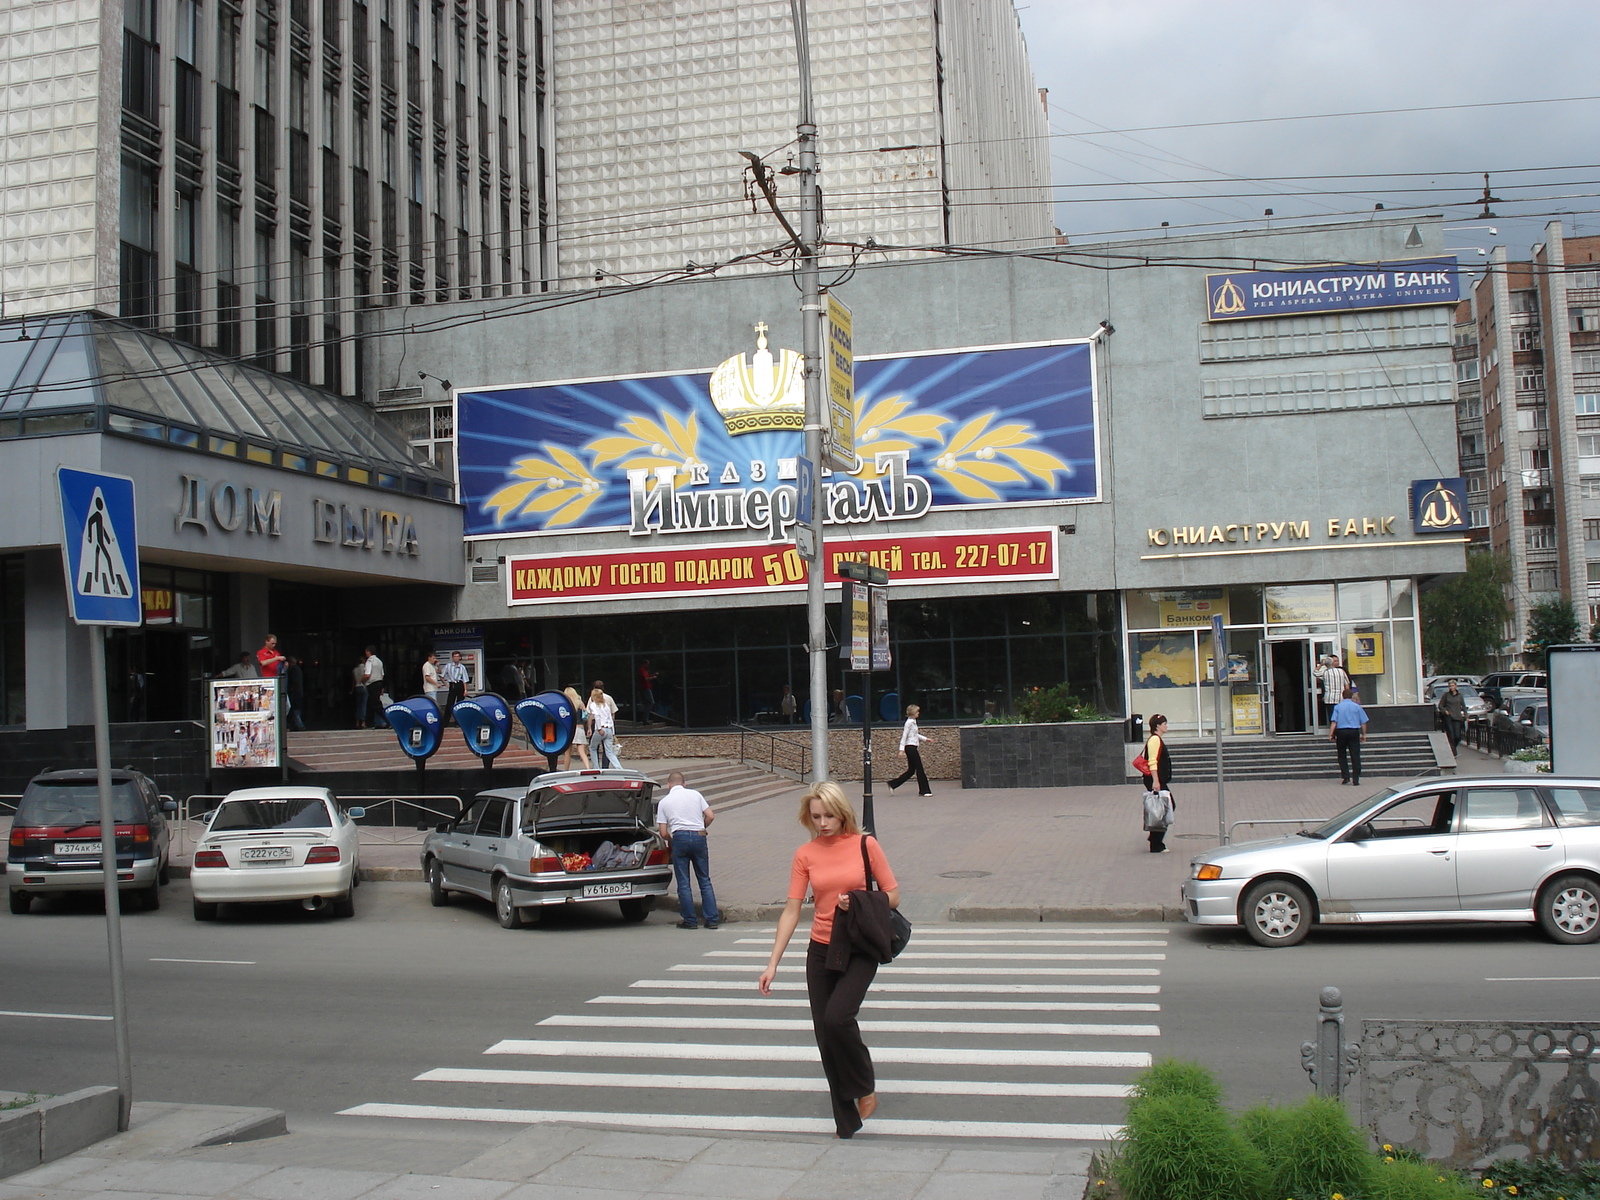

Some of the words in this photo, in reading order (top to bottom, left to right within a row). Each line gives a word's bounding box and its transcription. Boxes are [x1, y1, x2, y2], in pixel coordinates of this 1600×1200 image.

[1252, 273, 1386, 299] ЮНИАСТРУМ
[1394, 270, 1450, 288] БАНК
[1254, 300, 1275, 308] PER
[1280, 297, 1322, 306] ASPERA
[1328, 295, 1342, 303] AD
[1349, 291, 1383, 301] ASTRA
[1396, 287, 1453, 297] UNIVERSI
[627, 450, 934, 545] ИмпералЪ
[175, 474, 283, 537] ДОМ
[313, 498, 421, 557] БЫТА
[1148, 519, 1311, 547] ЮНИАСТРУМ
[1327, 515, 1397, 538] БАНК
[516, 565, 602, 592] КАЖДОМУ
[610, 561, 666, 586] ГОСТЮ
[674, 557, 754, 585] ПОДАРОК
[911, 551, 948, 571] тел.
[954, 541, 1048, 569] 227-07-17
[434, 627, 476, 635] БАНКОМАТ
[385, 705, 412, 716] ТАКСОФОН
[453, 702, 481, 712] ТАКСОФОН
[516, 700, 545, 711] ТАКСОФОН
